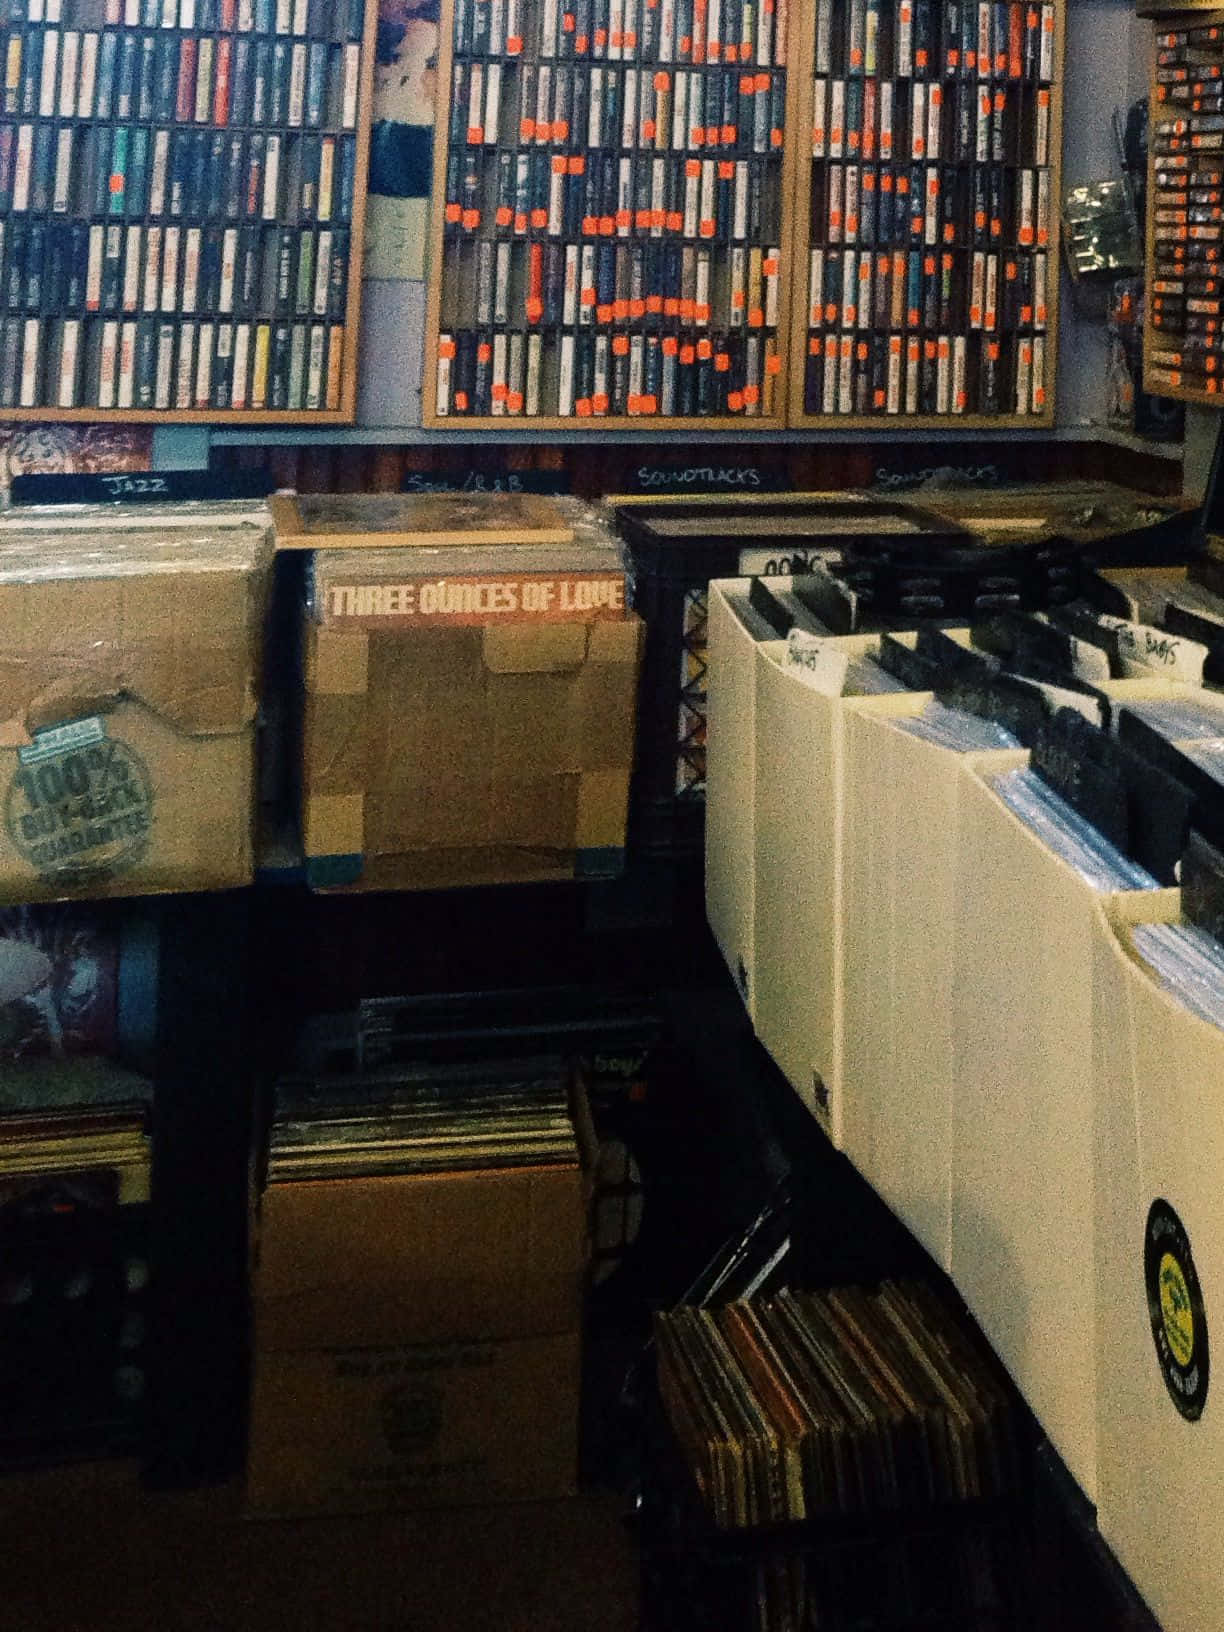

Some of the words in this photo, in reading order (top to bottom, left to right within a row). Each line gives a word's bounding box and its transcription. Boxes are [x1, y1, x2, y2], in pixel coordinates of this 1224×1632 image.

[331, 585, 415, 617] THREE
[419, 582, 519, 615] OUNCES
[522, 581, 555, 612] OF
[559, 580, 626, 611] LOVE
